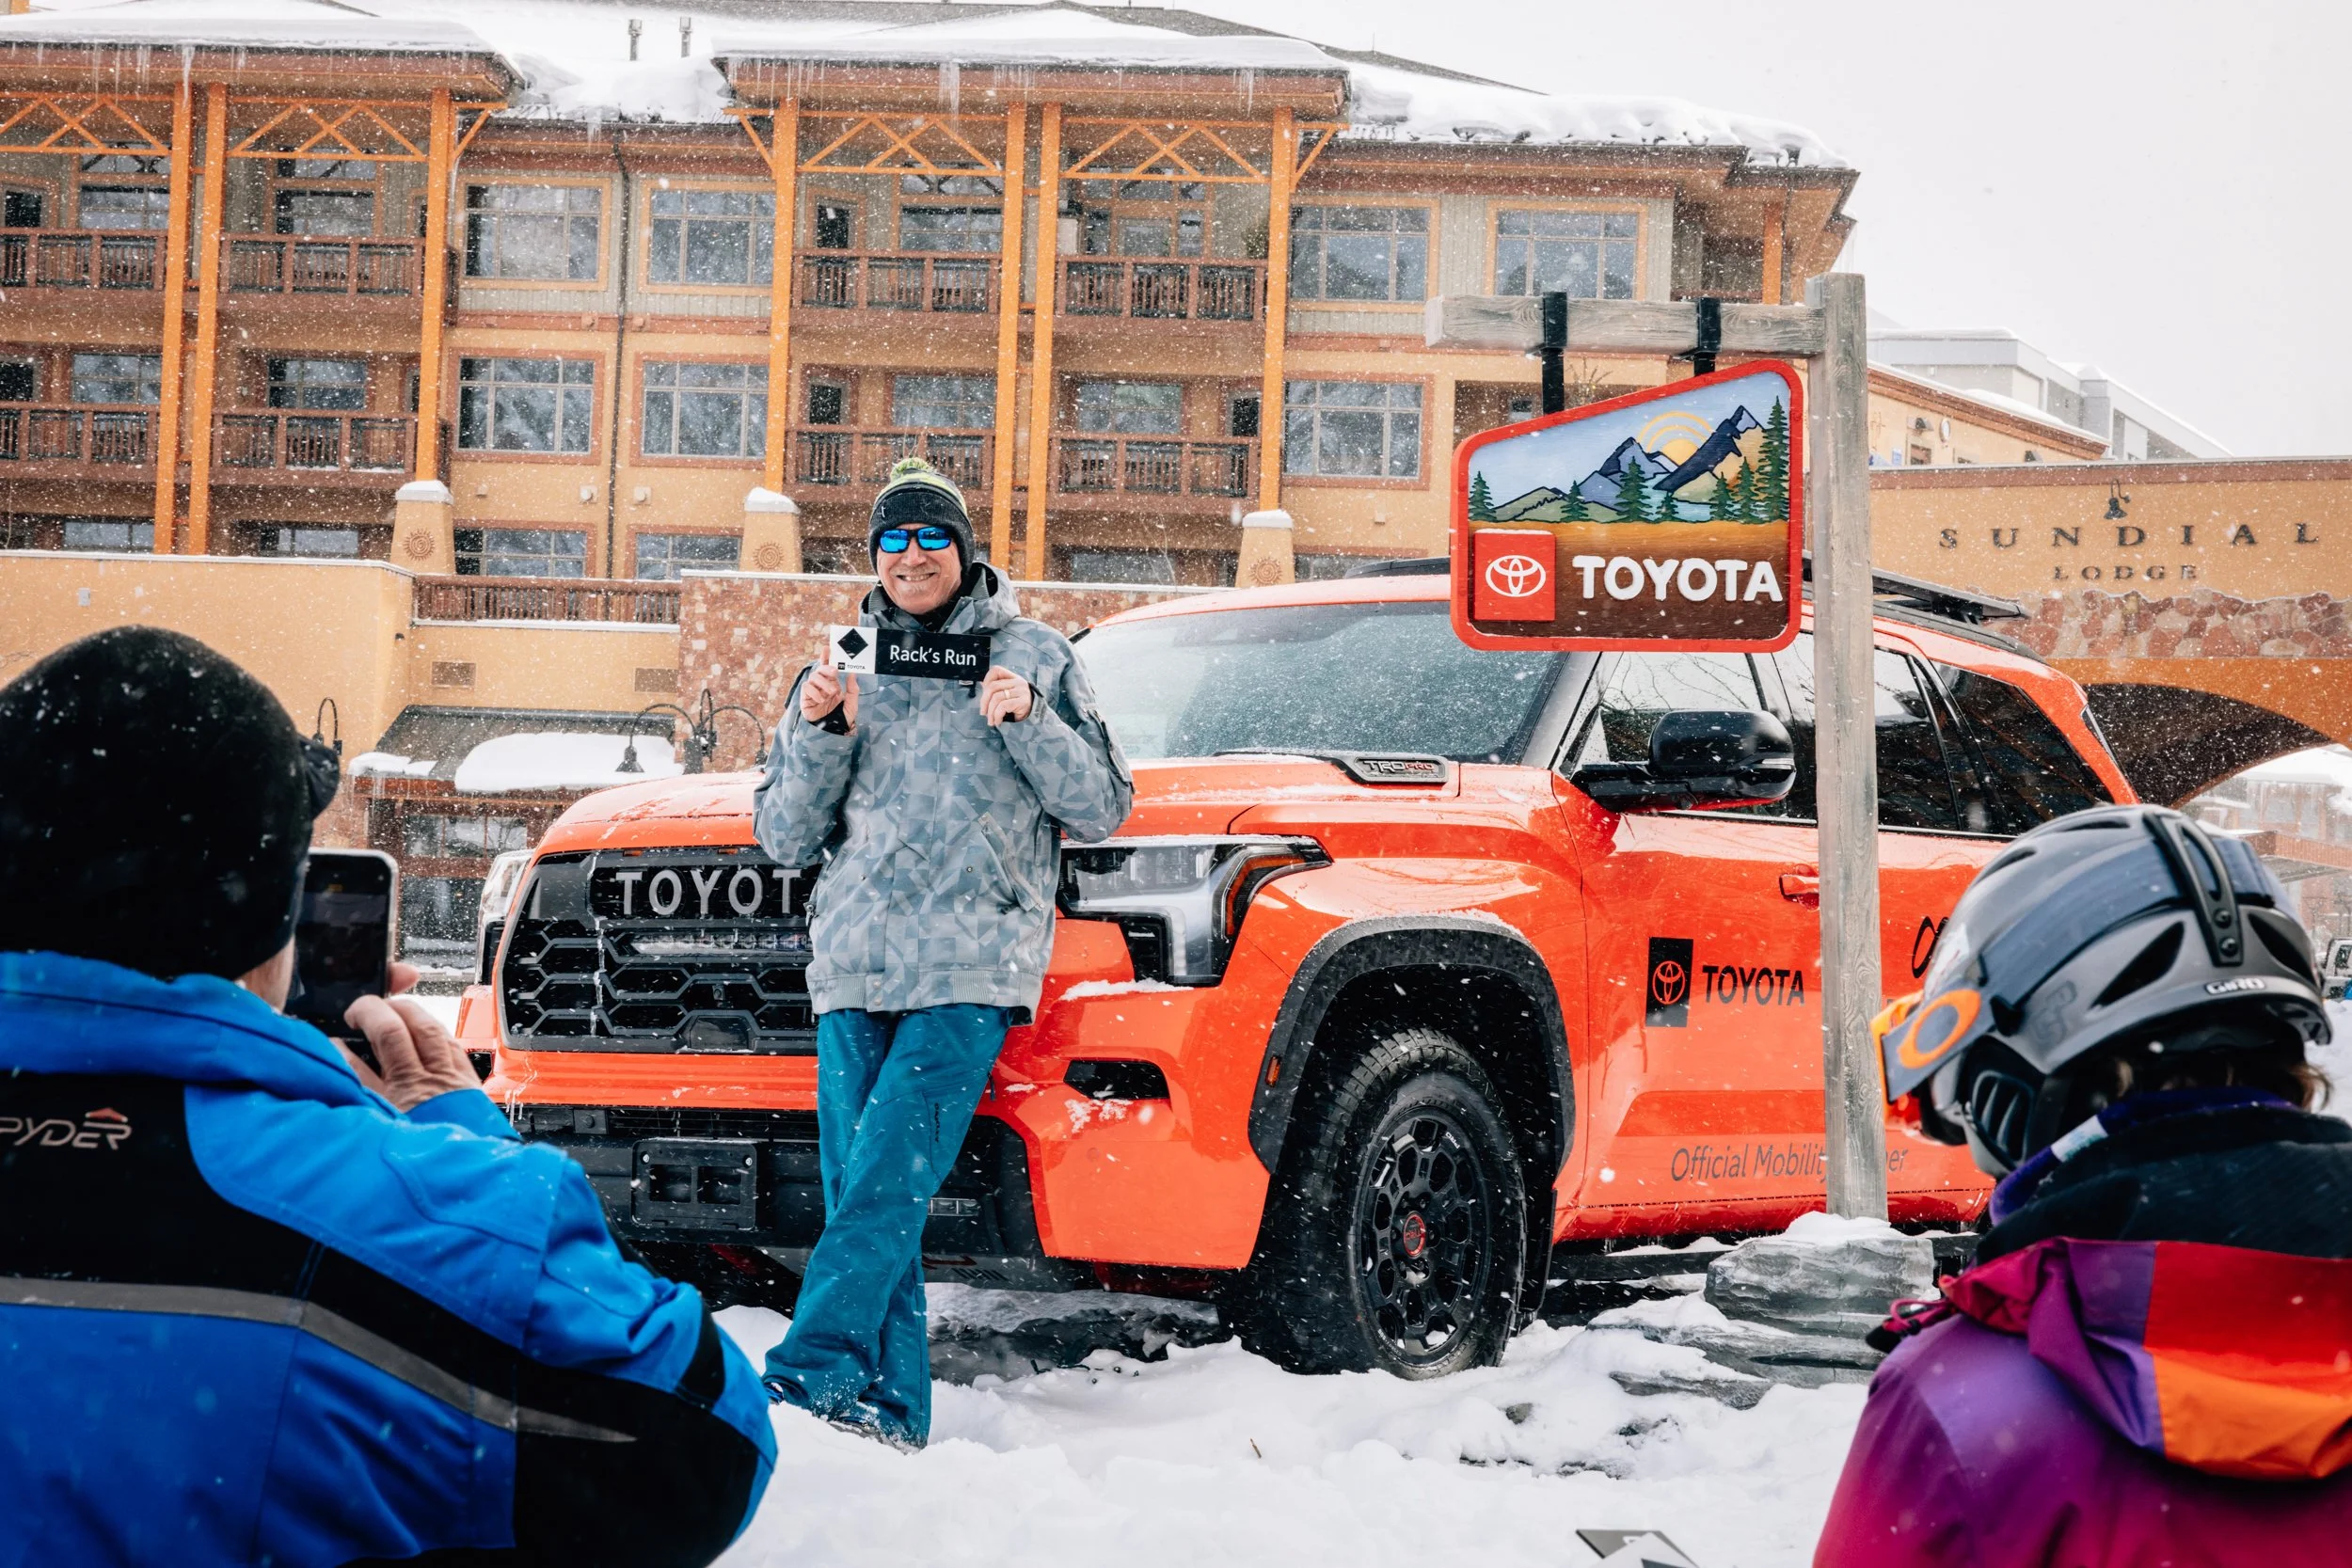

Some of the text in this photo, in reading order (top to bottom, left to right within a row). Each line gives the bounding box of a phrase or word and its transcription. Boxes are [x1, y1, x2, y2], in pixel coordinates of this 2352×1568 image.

[1939, 522, 2320, 550] SUNDIAL
[1572, 555, 1783, 602] TOYOTA
[2054, 564, 2198, 581] LODGE
[889, 644, 977, 666] Rack's Run
[615, 868, 803, 915] TOYOT
[1702, 964, 1805, 1006] TOYOTA
[0, 1117, 133, 1149] PYDER
[1671, 1141, 1826, 1183] Official Mobilit
